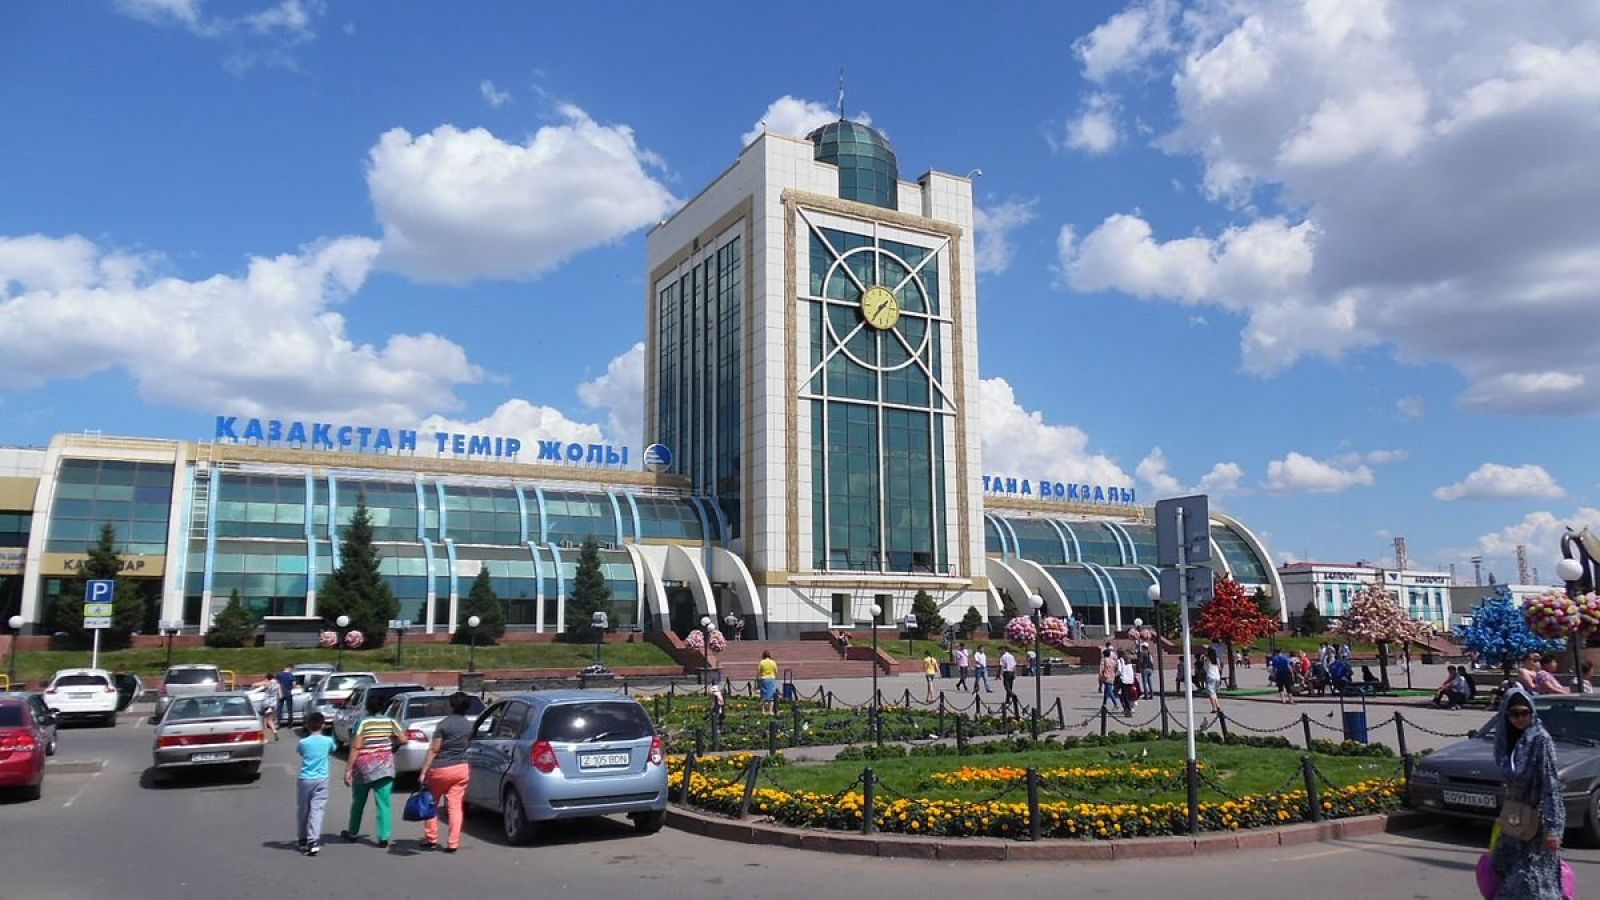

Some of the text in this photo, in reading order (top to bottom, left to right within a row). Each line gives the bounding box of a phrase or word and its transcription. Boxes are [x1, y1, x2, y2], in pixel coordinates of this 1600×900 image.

[215, 415, 628, 465] ҚАЗАҚСТАН ТЕМІР ЖОЛЫ
[1039, 480, 1136, 503] ВОКЗАЛЫ
[92, 582, 108, 600] P
